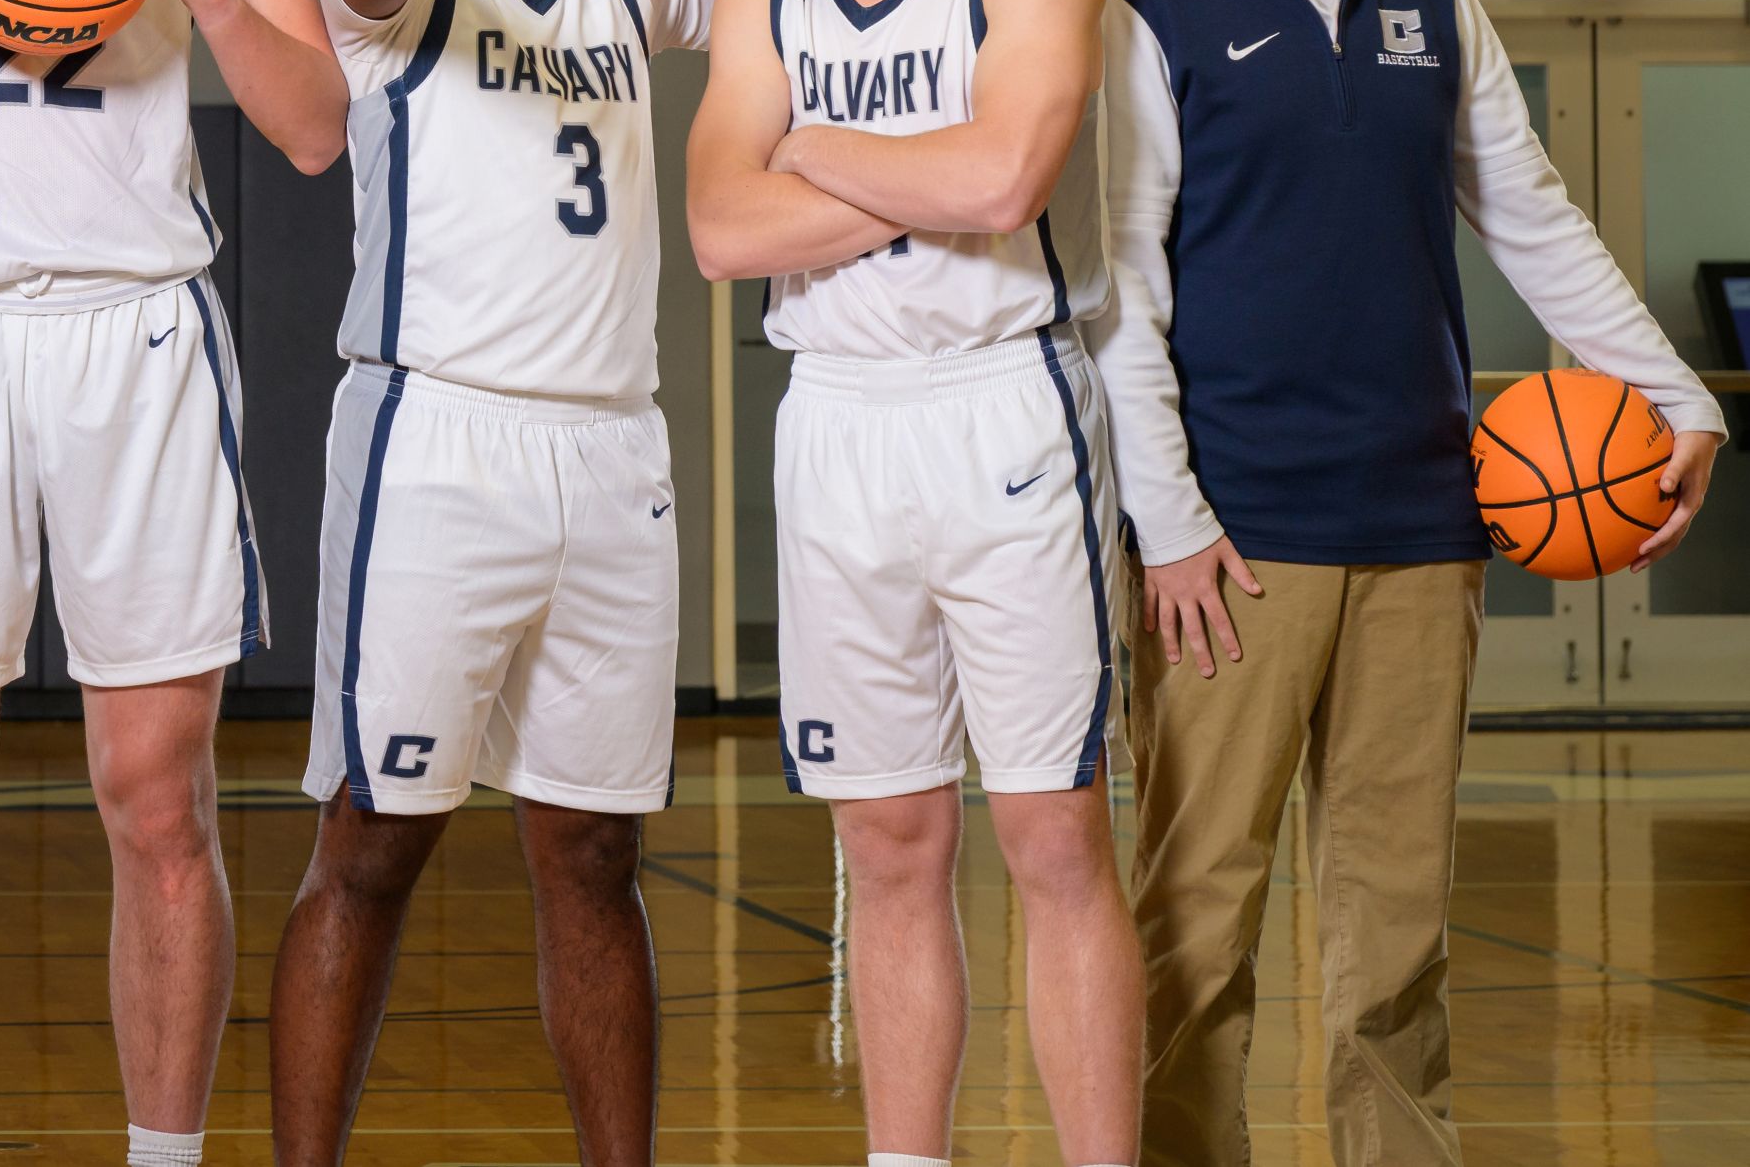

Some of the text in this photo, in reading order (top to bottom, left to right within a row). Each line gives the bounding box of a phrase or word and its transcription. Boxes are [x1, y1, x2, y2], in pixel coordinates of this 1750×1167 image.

[799, 45, 945, 122] CLVARY
[1377, 53, 1440, 67] BASKETBALL
[553, 122, 609, 239] 3
[378, 733, 438, 780] C
[797, 718, 835, 764] C
